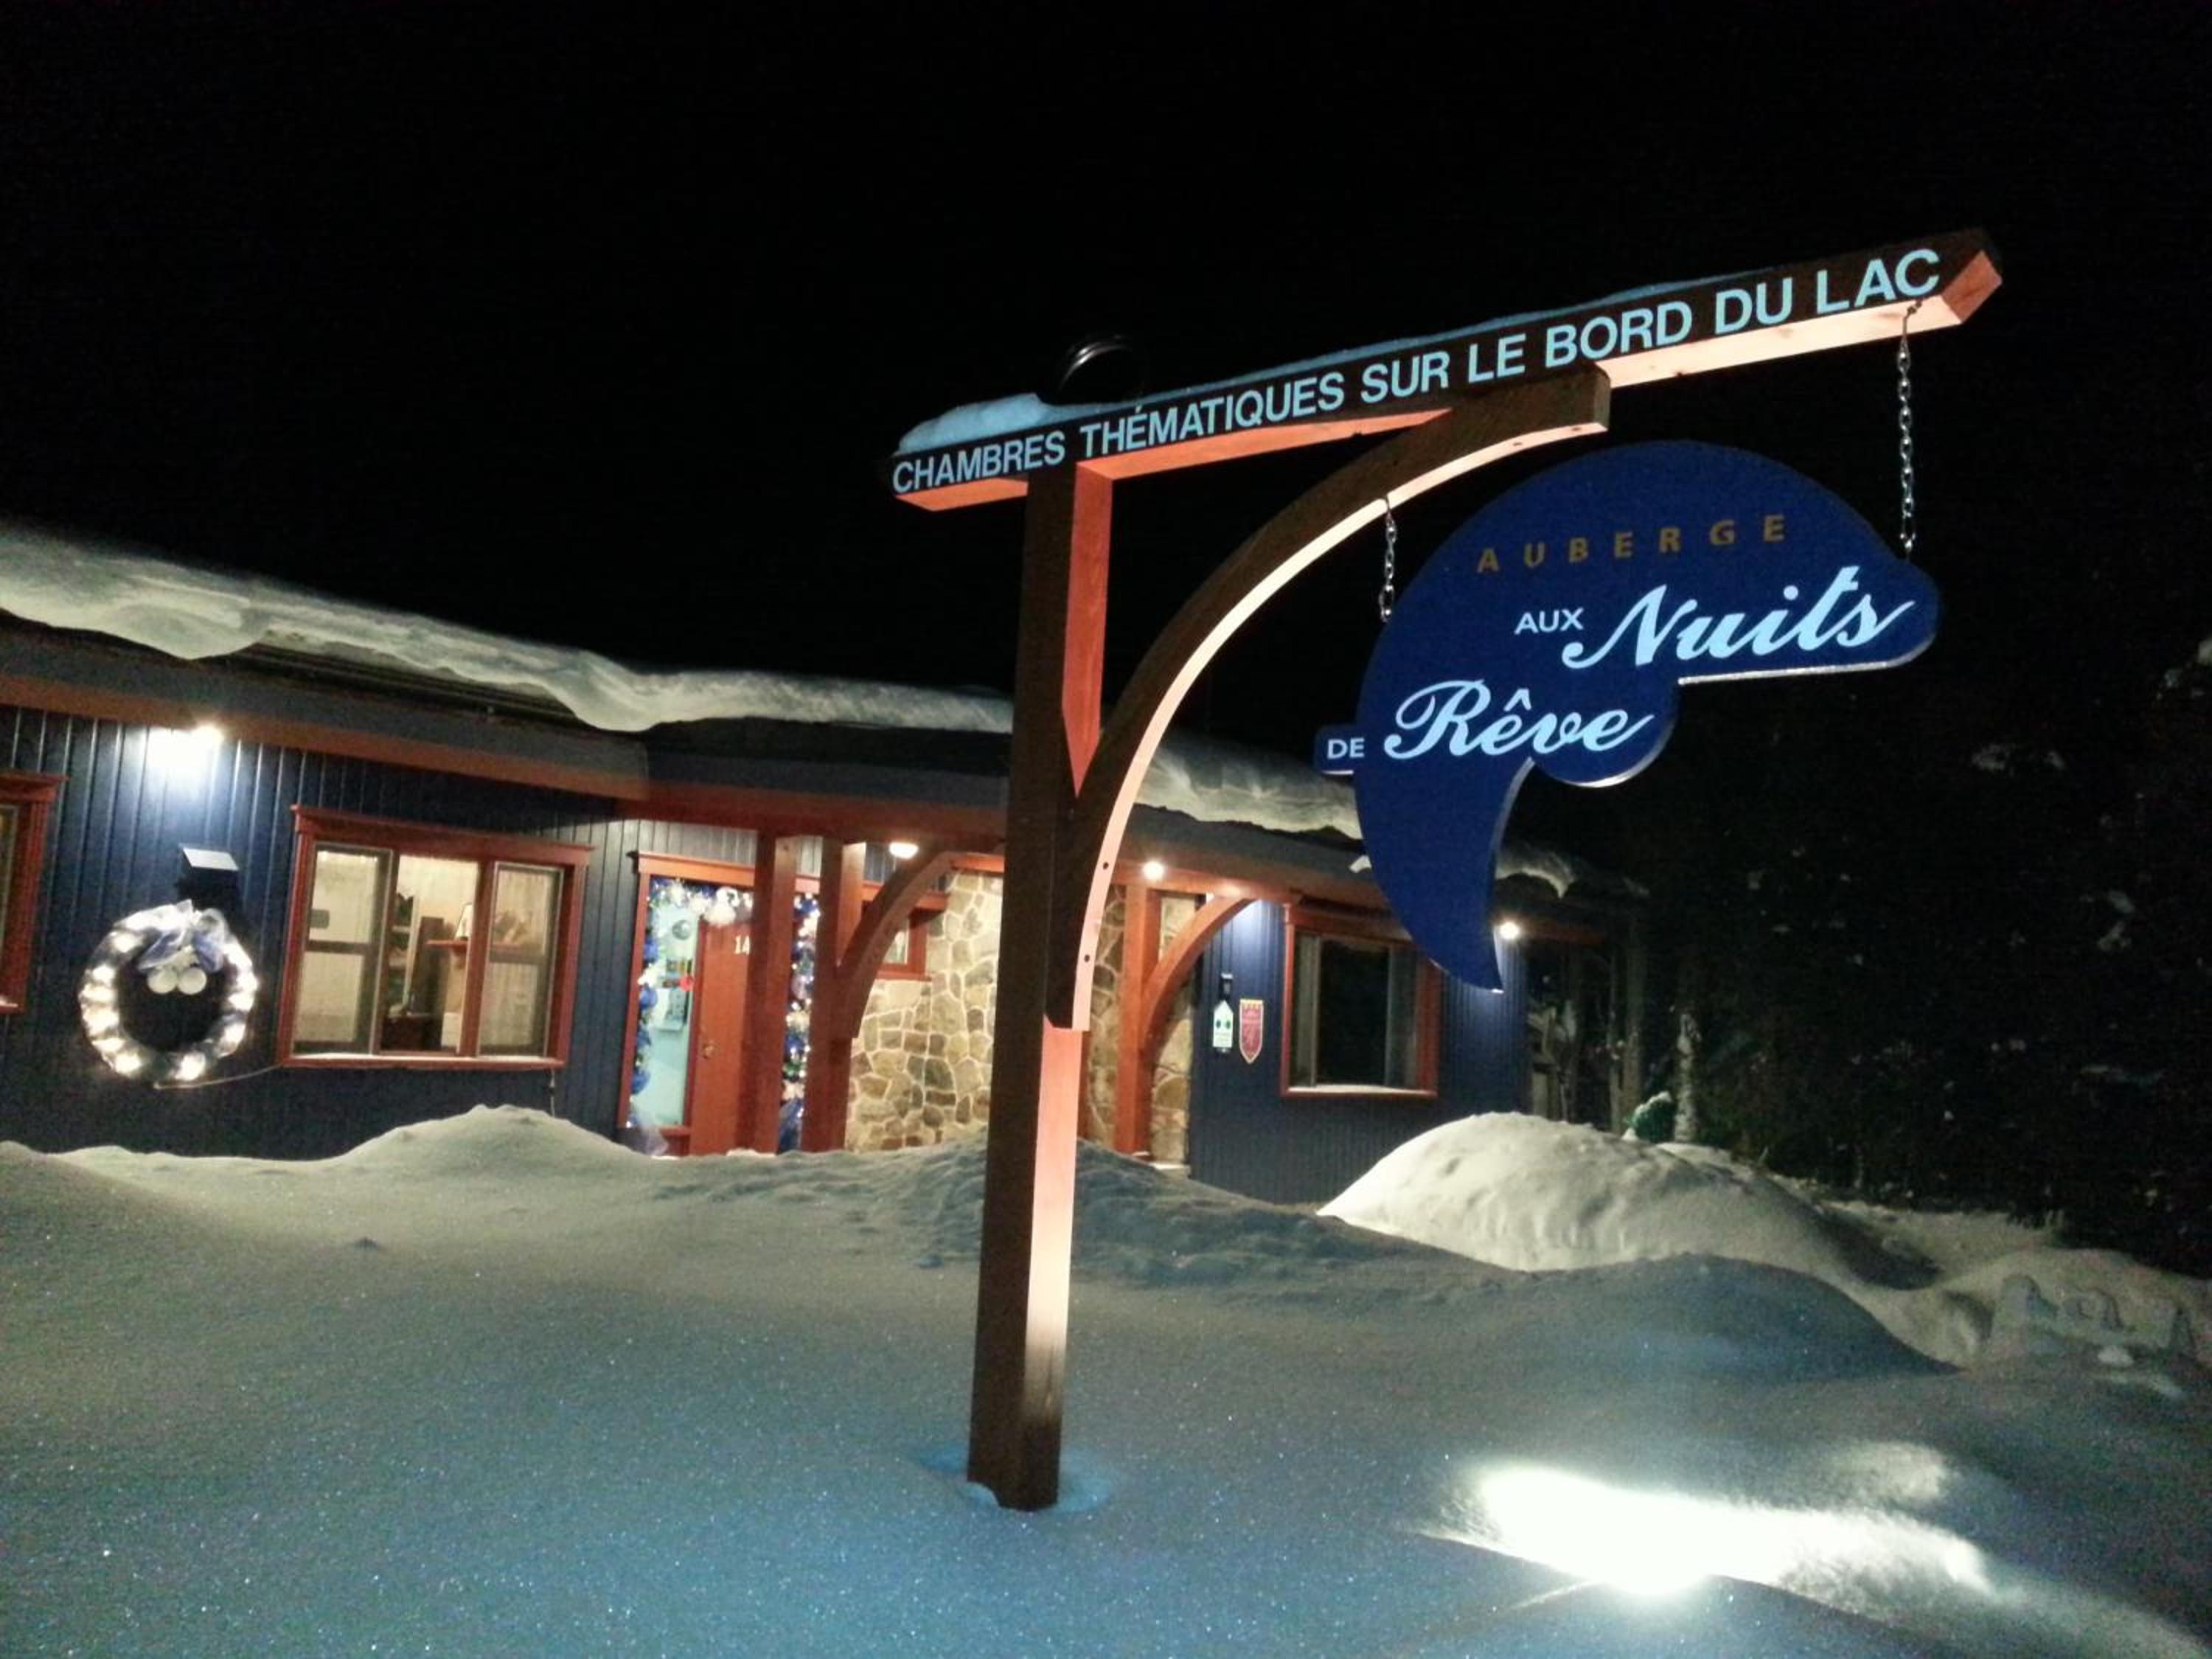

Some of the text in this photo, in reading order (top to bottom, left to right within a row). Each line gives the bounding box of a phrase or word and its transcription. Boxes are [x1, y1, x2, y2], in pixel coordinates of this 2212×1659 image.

[892, 248, 1940, 493] CHAMBRES THÉMATIQUES SUR LE BORD DU LAC
[1477, 515, 1785, 574] AUBERGE
[1514, 565, 1916, 669] AUX Nuits
[1327, 679, 1655, 759] DE Rêve
